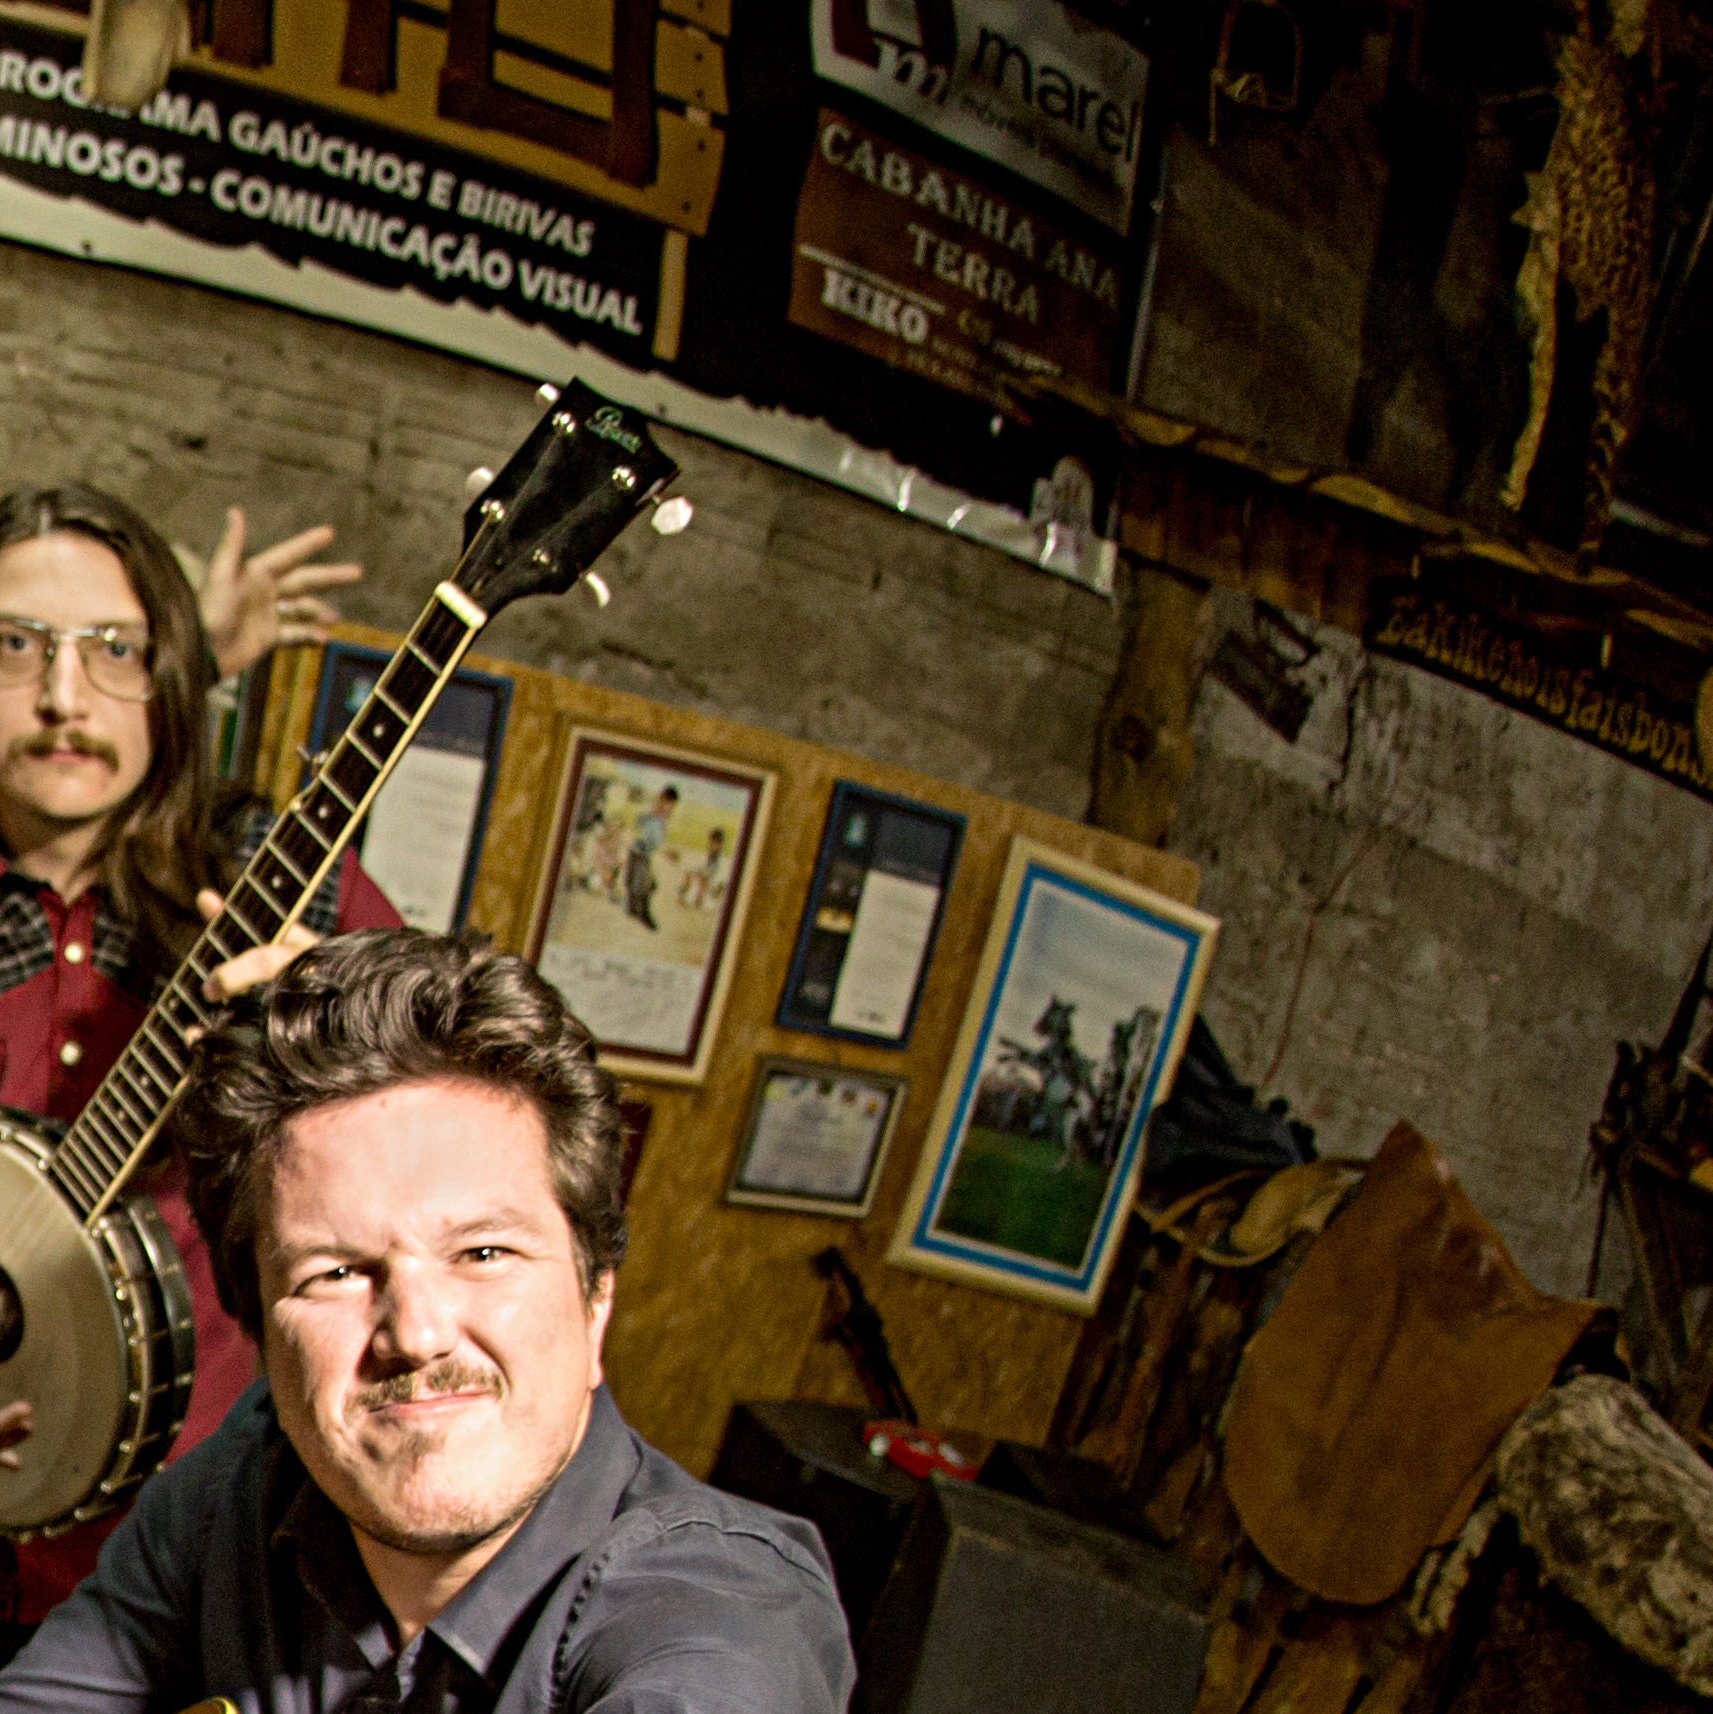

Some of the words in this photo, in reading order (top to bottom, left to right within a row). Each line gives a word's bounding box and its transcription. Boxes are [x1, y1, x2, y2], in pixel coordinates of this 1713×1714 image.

[971, 26, 1142, 164] marel
[209, 168, 513, 289] COMUNICAÇÃO
[515, 259, 643, 337] VISUAL
[228, 109, 426, 200] GAÚCHOS
[428, 170, 456, 211] E
[458, 181, 596, 258] BIRIVAS
[820, 122, 1036, 260] CABANHA
[1043, 238, 1120, 312] ANA
[821, 266, 931, 346] KIKO
[906, 222, 1040, 326] TERRA
